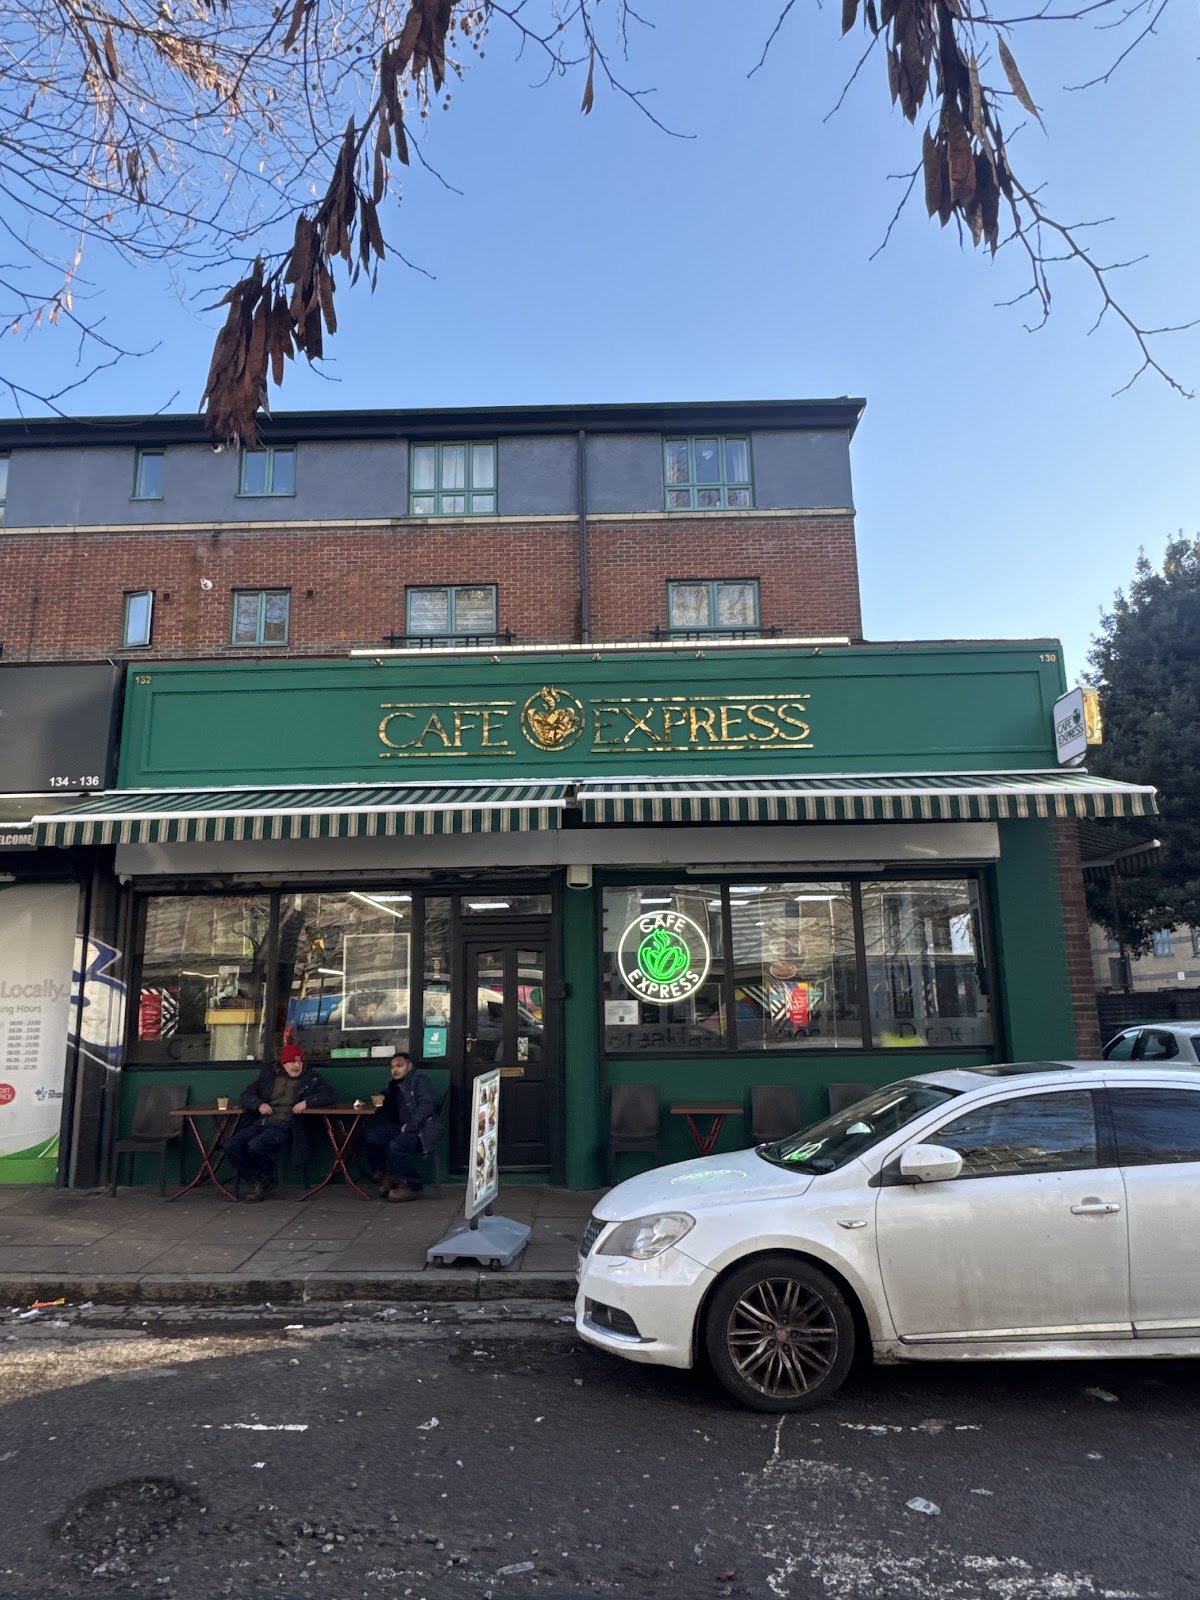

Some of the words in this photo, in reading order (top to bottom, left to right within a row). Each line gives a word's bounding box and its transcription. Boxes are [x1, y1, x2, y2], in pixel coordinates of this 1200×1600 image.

[1039, 654, 1056, 662] 130
[135, 675, 152, 684] 132
[378, 710, 508, 748] CAFE
[593, 703, 810, 744] EXPRESS
[1056, 718, 1073, 734] CAFE
[1057, 724, 1084, 745] EXPRESS
[49, 777, 69, 786] 134
[79, 776, 99, 786] 136
[639, 914, 686, 933] CAFE
[627, 968, 700, 998] EXPRESS
[17, 1005, 42, 1013] Hours
